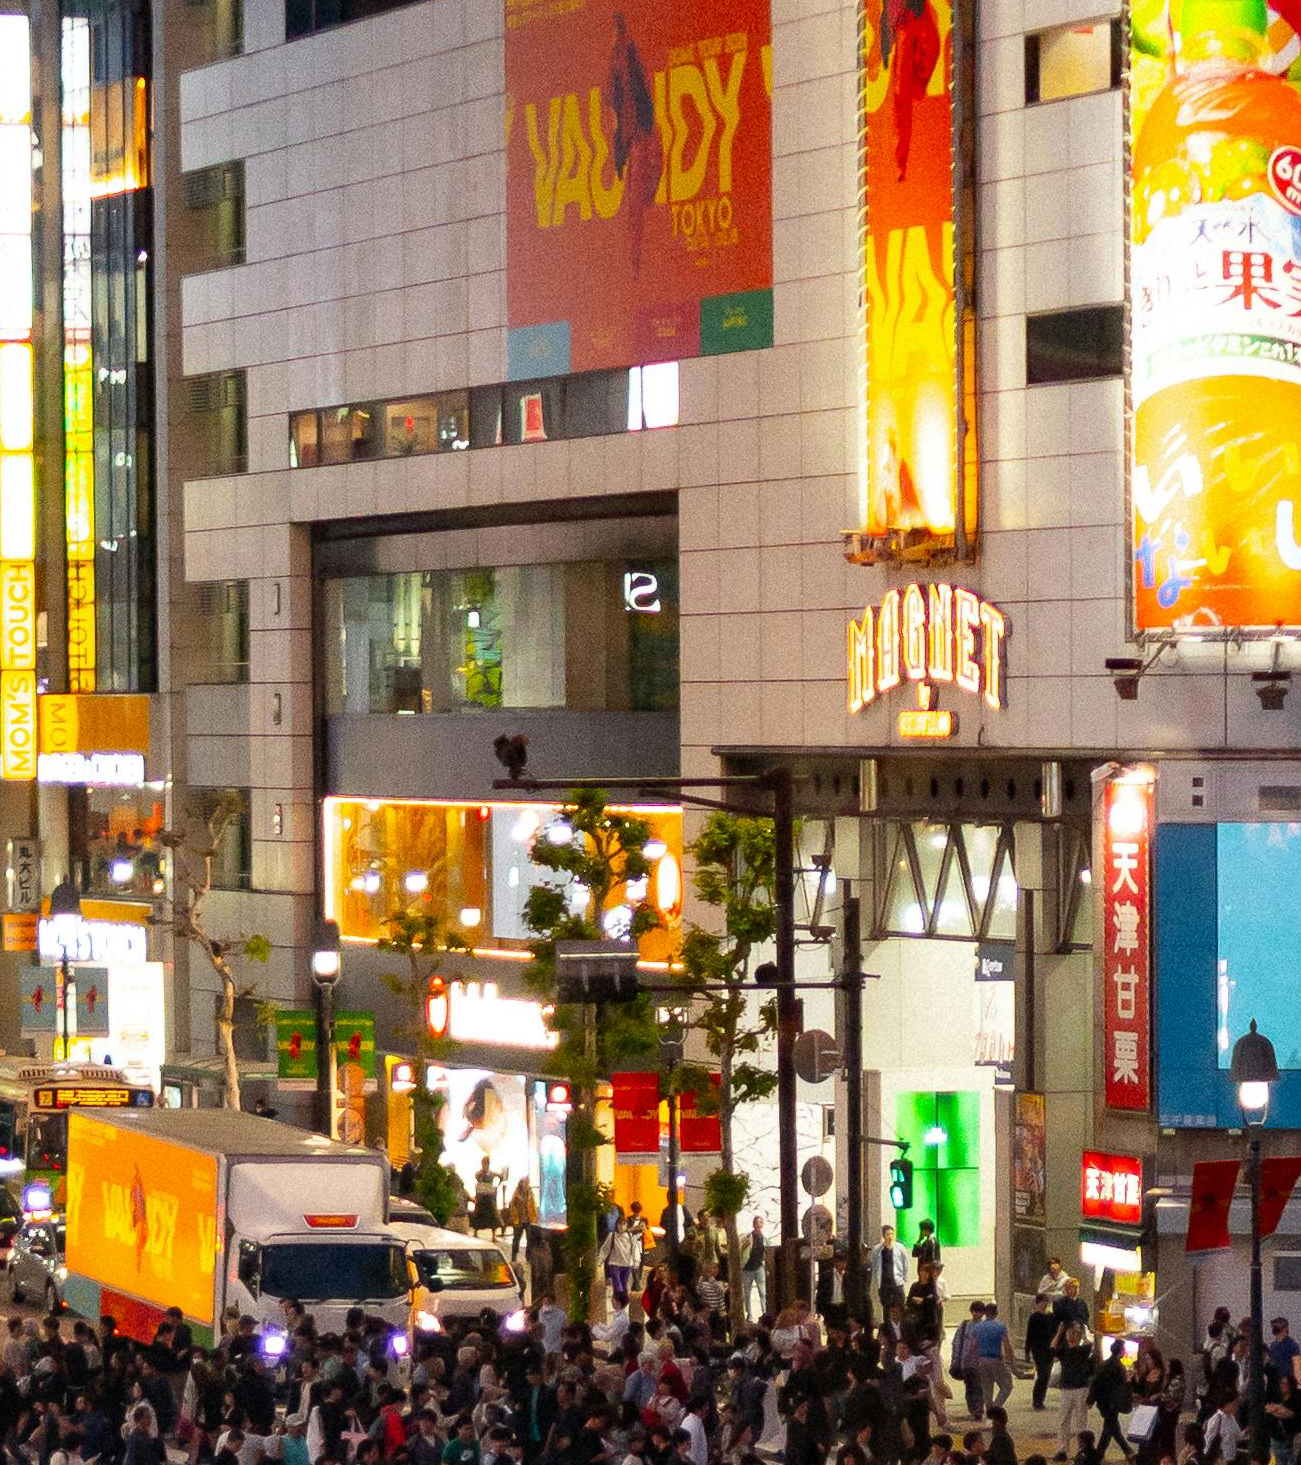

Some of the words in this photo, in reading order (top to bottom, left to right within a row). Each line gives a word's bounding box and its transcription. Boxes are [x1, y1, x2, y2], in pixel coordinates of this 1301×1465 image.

[671, 195, 733, 237] TOKYO
[9, 565, 30, 667] TOUCH
[848, 583, 1005, 714] MAGNET
[10, 674, 31, 774] MOM'S
[16, 846, 32, 905] 丸大ビル
[1111, 842, 1140, 1085] 天津甘栗
